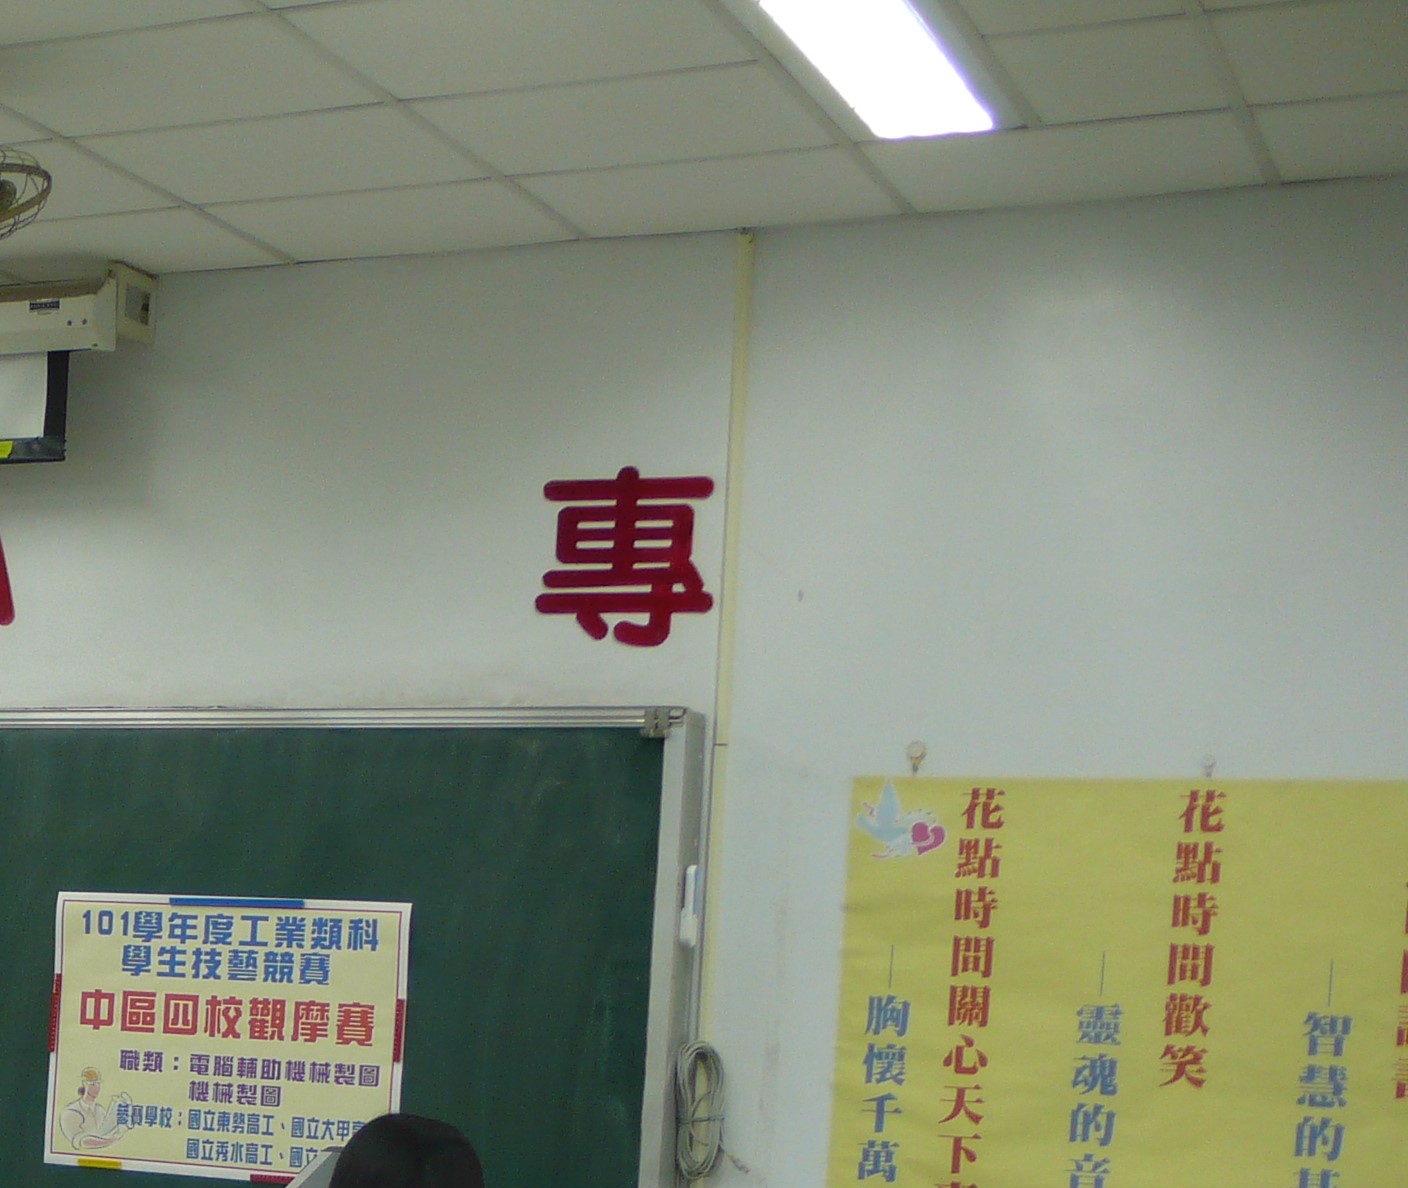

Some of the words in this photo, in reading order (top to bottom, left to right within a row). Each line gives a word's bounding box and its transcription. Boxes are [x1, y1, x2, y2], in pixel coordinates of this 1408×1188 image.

[535, 466, 715, 647] 專
[81, 908, 379, 952] 101學年度工業類科
[1158, 788, 1227, 1090] 花點時間歡笑
[120, 943, 332, 986] 學生技藝競賽
[79, 988, 376, 1048] 中區四校觀摩賽
[188, 1080, 282, 1108] 機械製圖
